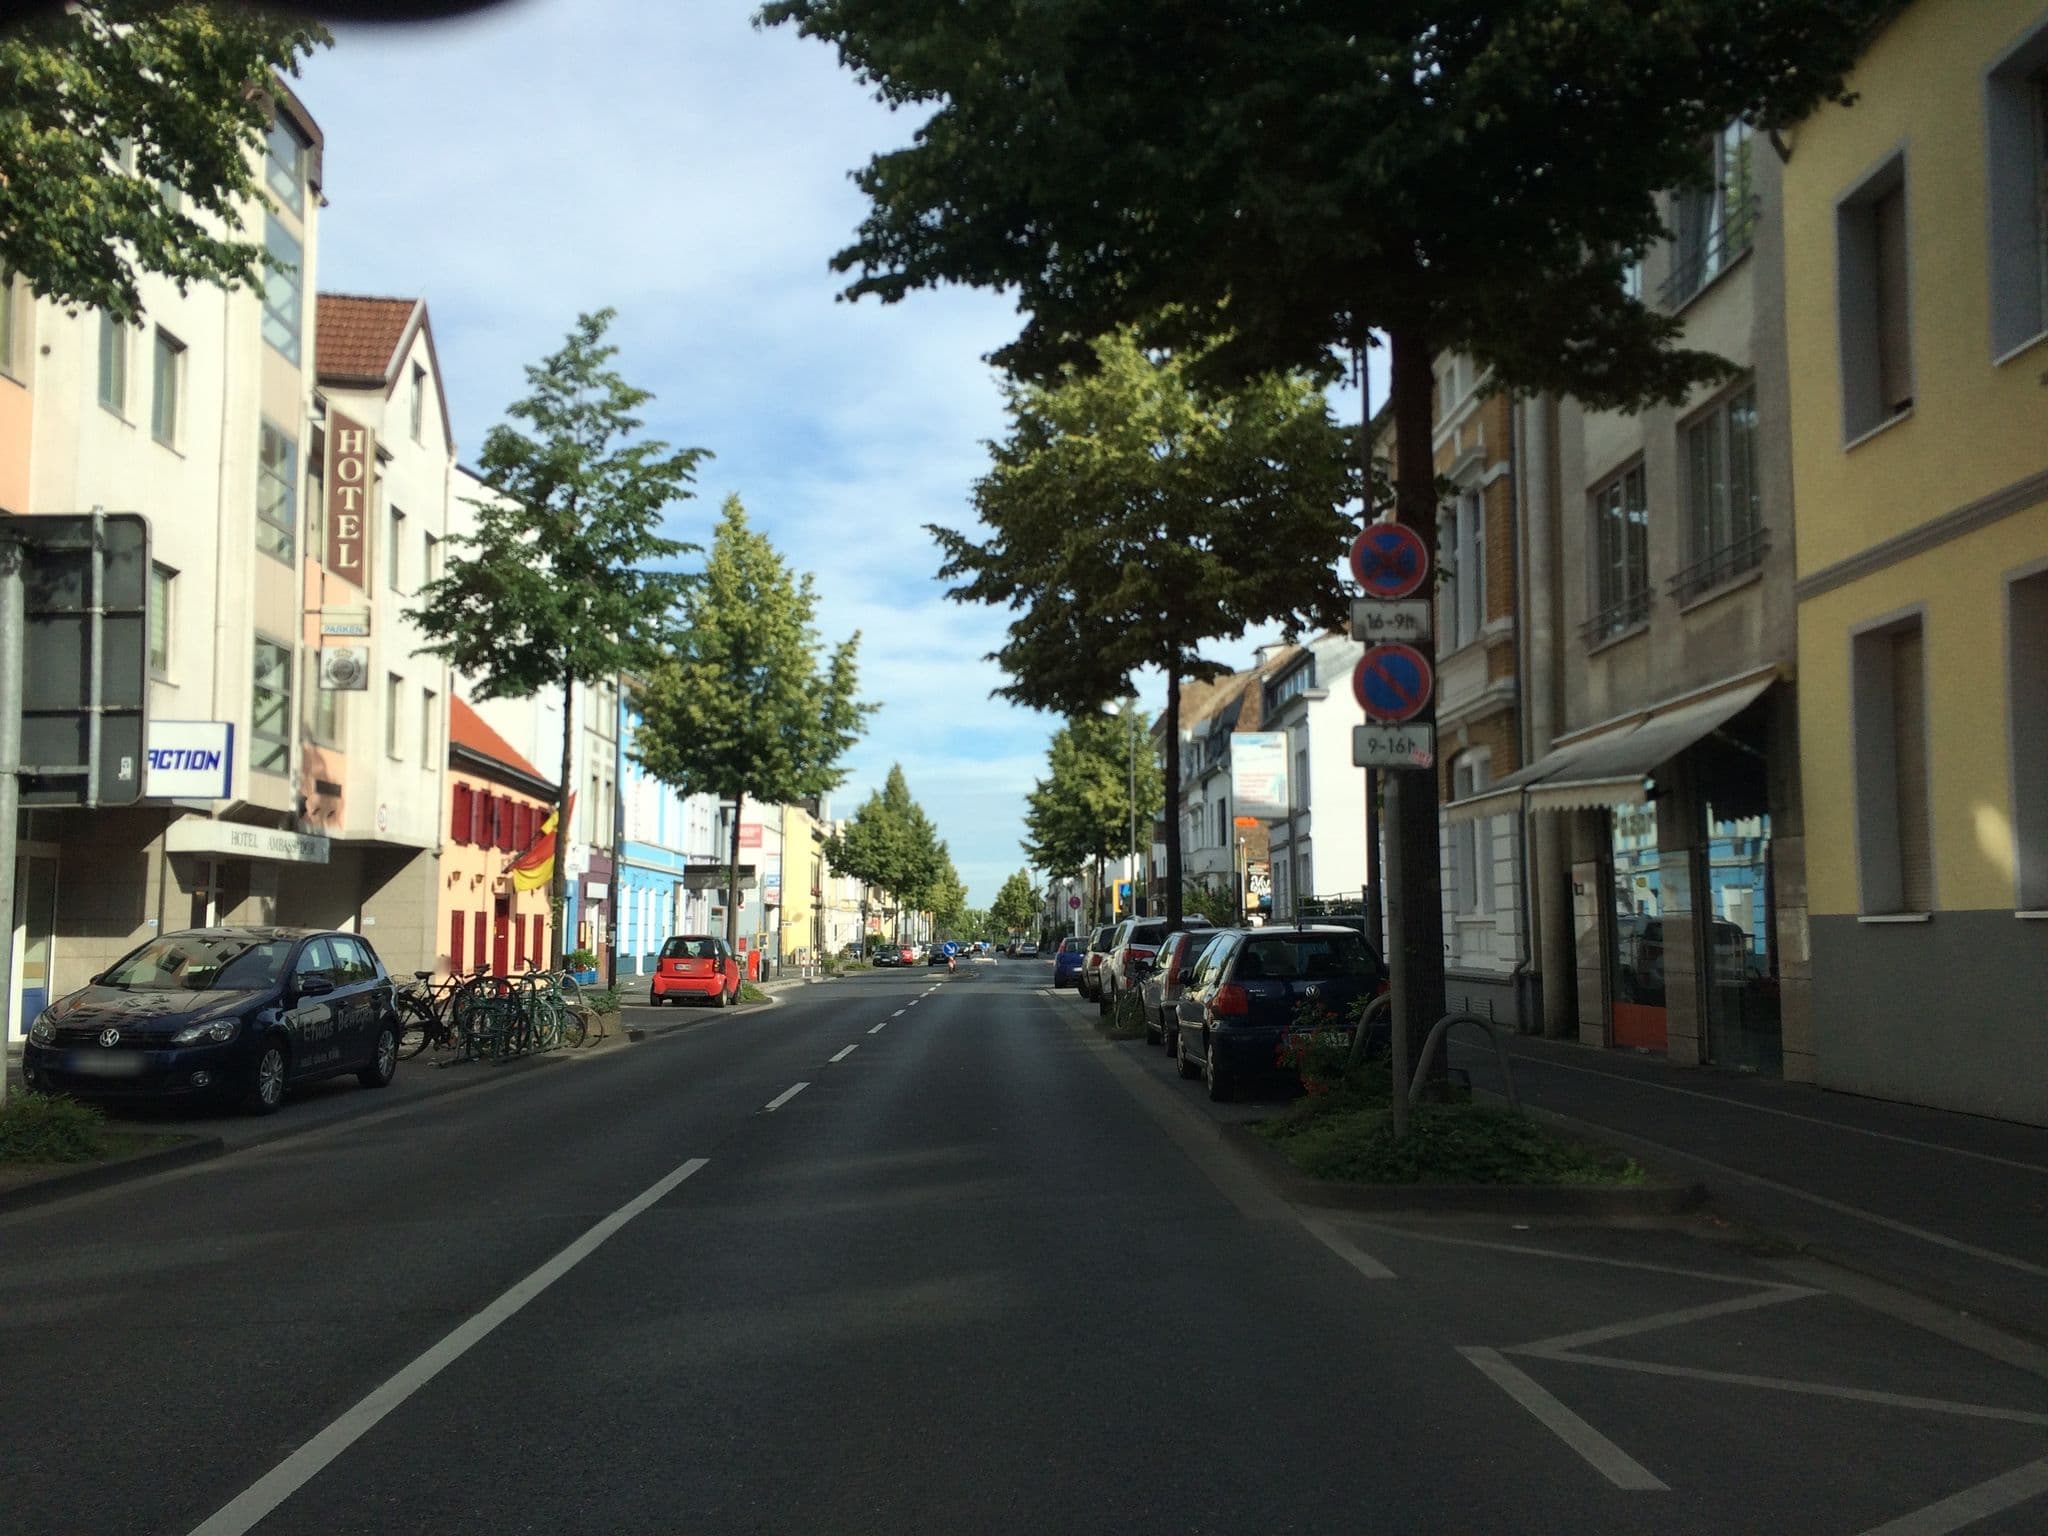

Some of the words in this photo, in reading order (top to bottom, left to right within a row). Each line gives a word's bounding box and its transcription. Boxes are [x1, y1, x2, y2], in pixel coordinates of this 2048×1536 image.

[337, 429, 364, 568] HOTEL
[148, 749, 221, 770] ACTION
[231, 830, 258, 848] HOTEL
